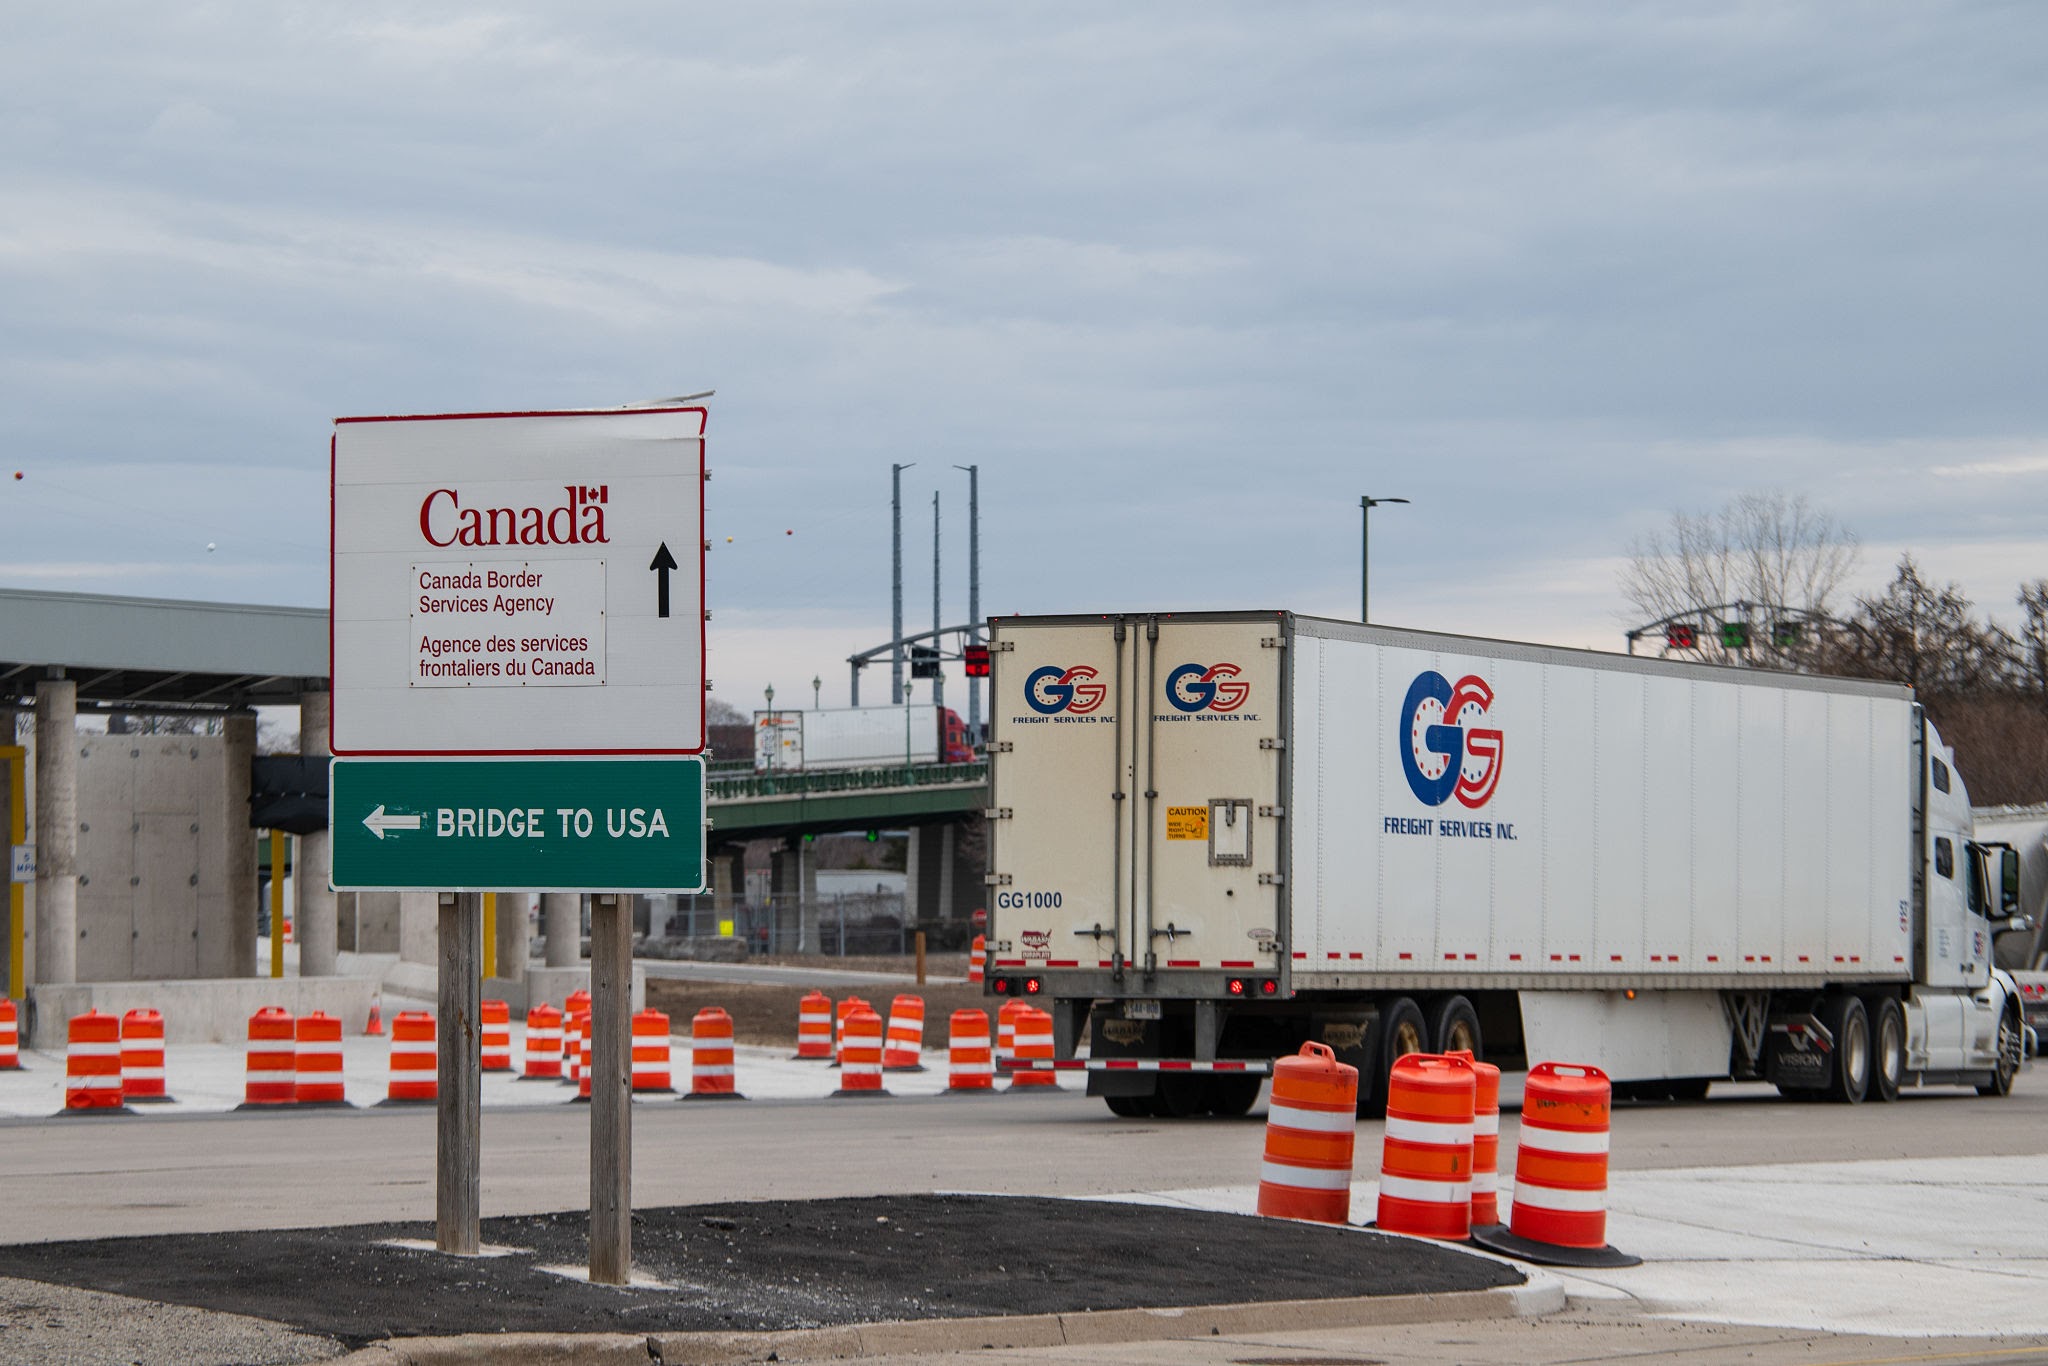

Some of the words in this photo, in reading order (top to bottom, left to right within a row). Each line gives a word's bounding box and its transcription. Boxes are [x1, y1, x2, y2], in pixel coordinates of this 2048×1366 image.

[419, 485, 611, 548] Canada
[419, 570, 483, 590] Canada
[486, 570, 543, 589] Border
[419, 595, 489, 613] Services
[492, 594, 555, 617] Agency
[419, 635, 482, 658] Agence
[486, 634, 516, 653] des
[520, 633, 589, 652] services
[419, 658, 501, 677] frontaliers
[505, 658, 527, 676] du
[531, 657, 596, 676] Canada
[1012, 716, 1050, 724] FREIGHT
[1053, 715, 1097, 723] SERVICES
[1154, 714, 1192, 722] FREIGHT
[1168, 808, 1207, 816] CAUTION
[436, 808, 545, 839] BRIDGE
[556, 807, 594, 839] TO
[606, 807, 670, 839] USA
[1383, 816, 1434, 836] FREIGHT
[1439, 819, 1493, 839] SERVICES
[1496, 823, 1518, 841] INC.
[998, 891, 1063, 909] GG1000
